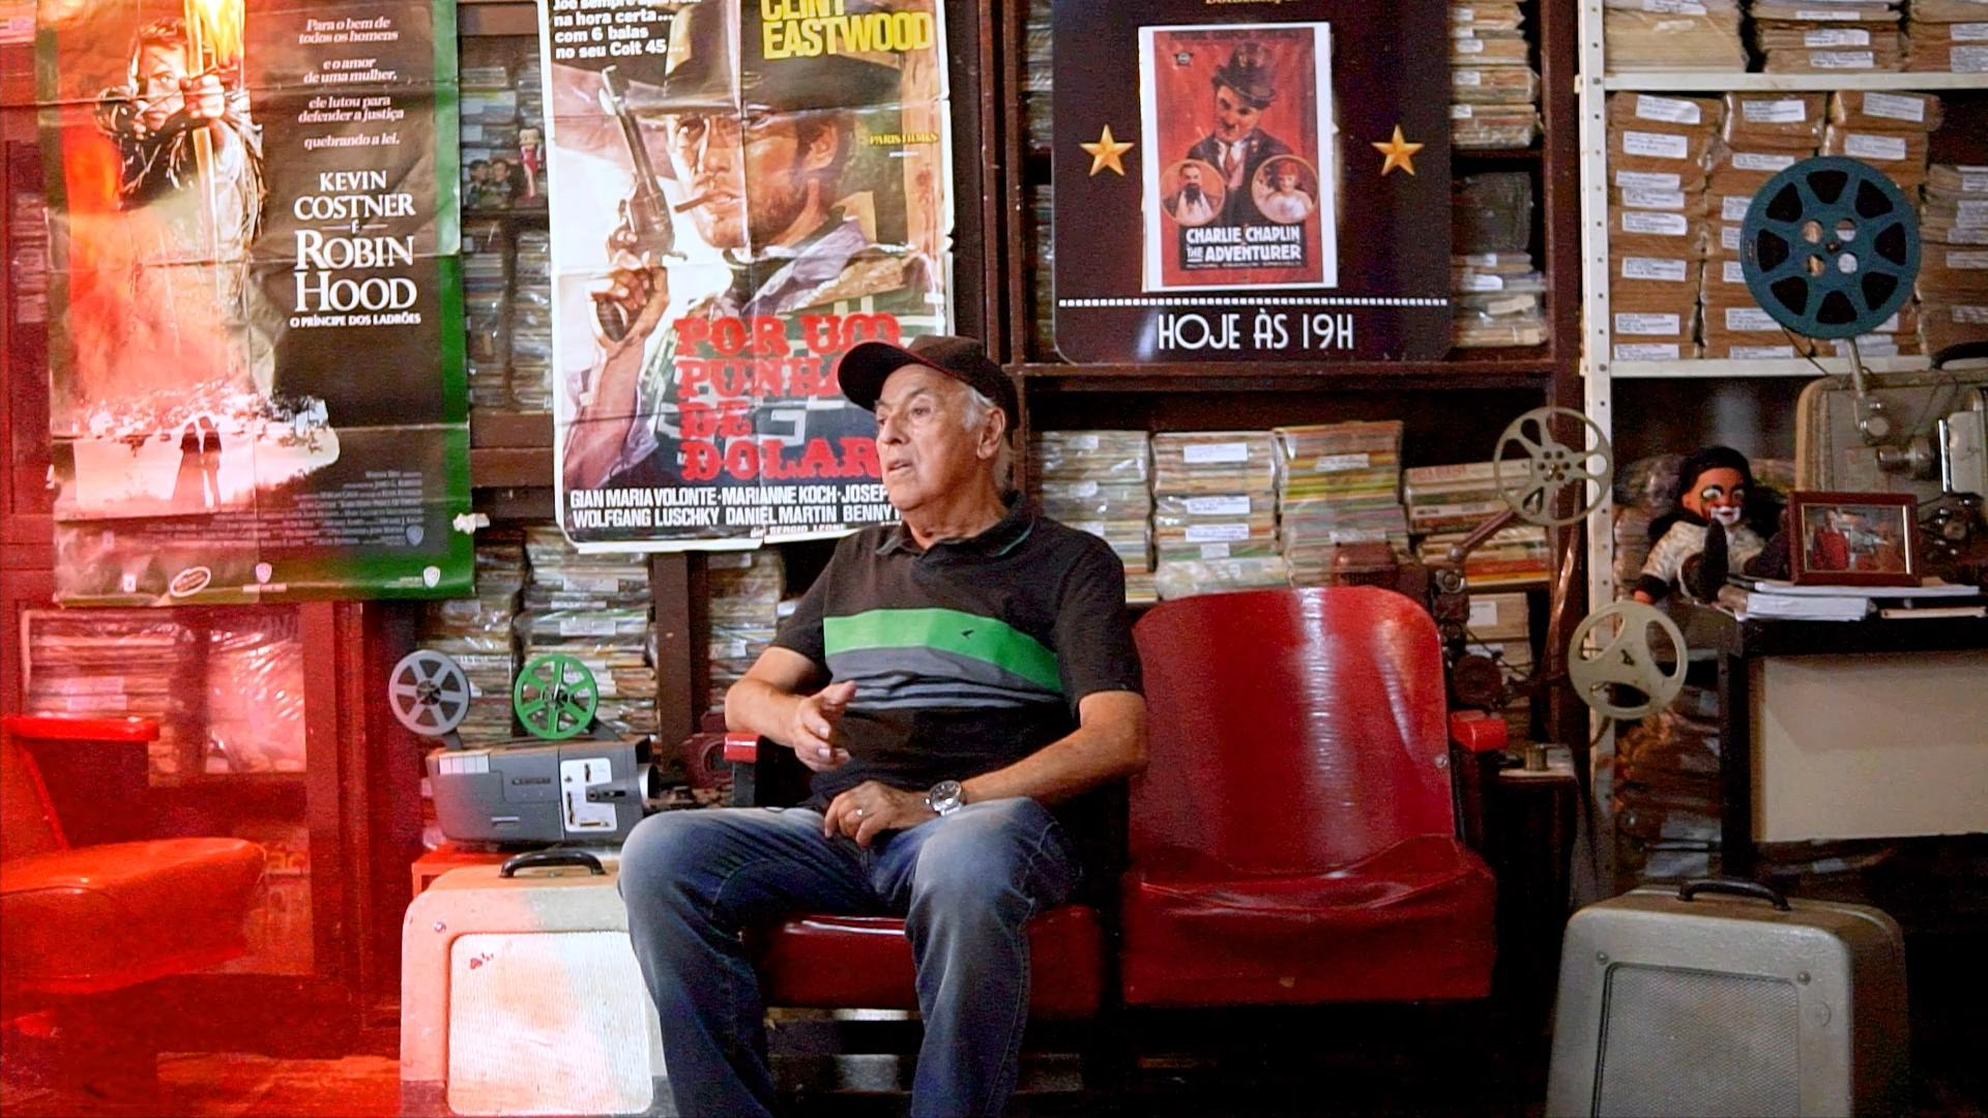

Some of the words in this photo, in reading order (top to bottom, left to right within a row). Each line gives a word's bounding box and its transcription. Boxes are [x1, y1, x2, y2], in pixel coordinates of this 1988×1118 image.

[553, 0, 578, 10] Joe
[761, 0, 845, 21] CLINT
[306, 18, 334, 32] Para
[336, 21, 345, 31] o
[346, 17, 373, 31] bem
[374, 16, 391, 29] de
[554, 15, 573, 27] na
[575, 11, 612, 26] hora
[615, 8, 674, 23] certa...
[298, 32, 332, 44] todos
[333, 32, 348, 43] os
[349, 30, 398, 42] homens
[554, 31, 588, 43] com
[591, 27, 603, 41] 6
[608, 25, 649, 40] balas
[762, 12, 934, 60] EASTWOOD
[555, 47, 575, 59] no
[578, 46, 606, 58] seu
[610, 41, 642, 56] Colt
[323, 60, 332, 70] e
[332, 60, 341, 69] o
[341, 58, 377, 69] amor
[303, 71, 319, 84] de
[321, 72, 349, 83] uma
[349, 69, 398, 82] mulher,
[308, 96, 327, 109] ele
[328, 96, 361, 109] lutou
[361, 96, 391, 110] para
[298, 109, 353, 123] defender
[353, 110, 362, 120] a
[362, 107, 405, 123] justiça
[304, 133, 371, 151] quebrando
[371, 135, 380, 146] a
[381, 132, 400, 146] lei.
[319, 170, 387, 192] KEVIN
[294, 193, 417, 221] COSTNER
[1186, 226, 1241, 244] CHARLIE
[1245, 224, 1300, 242] CHAPLIN
[294, 229, 415, 270] ROBIN
[1186, 246, 1203, 260] THE
[1205, 244, 1302, 262] ADVENTURER
[294, 271, 418, 312] HOOD
[290, 316, 300, 328] O
[301, 312, 346, 327] PRÍNCIPE
[348, 314, 371, 326] DOS
[373, 311, 422, 325] LADRÕES
[1158, 313, 1241, 350] HOJE
[1253, 307, 1289, 350] ÀS
[1302, 313, 1354, 350] 19H
[674, 315, 790, 357] POR
[678, 400, 752, 438] DE
[570, 489, 604, 508] GIAN
[605, 488, 654, 508] MARIA
[654, 487, 716, 506] VOLONTE
[722, 485, 797, 506] MARIANNE
[798, 485, 837, 504] KOCH
[573, 508, 651, 528] WOLFGANG
[655, 507, 719, 526] LUSCHKY
[725, 506, 777, 526] DANIEL
[778, 505, 837, 525] MARTIN
[843, 504, 892, 522] BENNY
